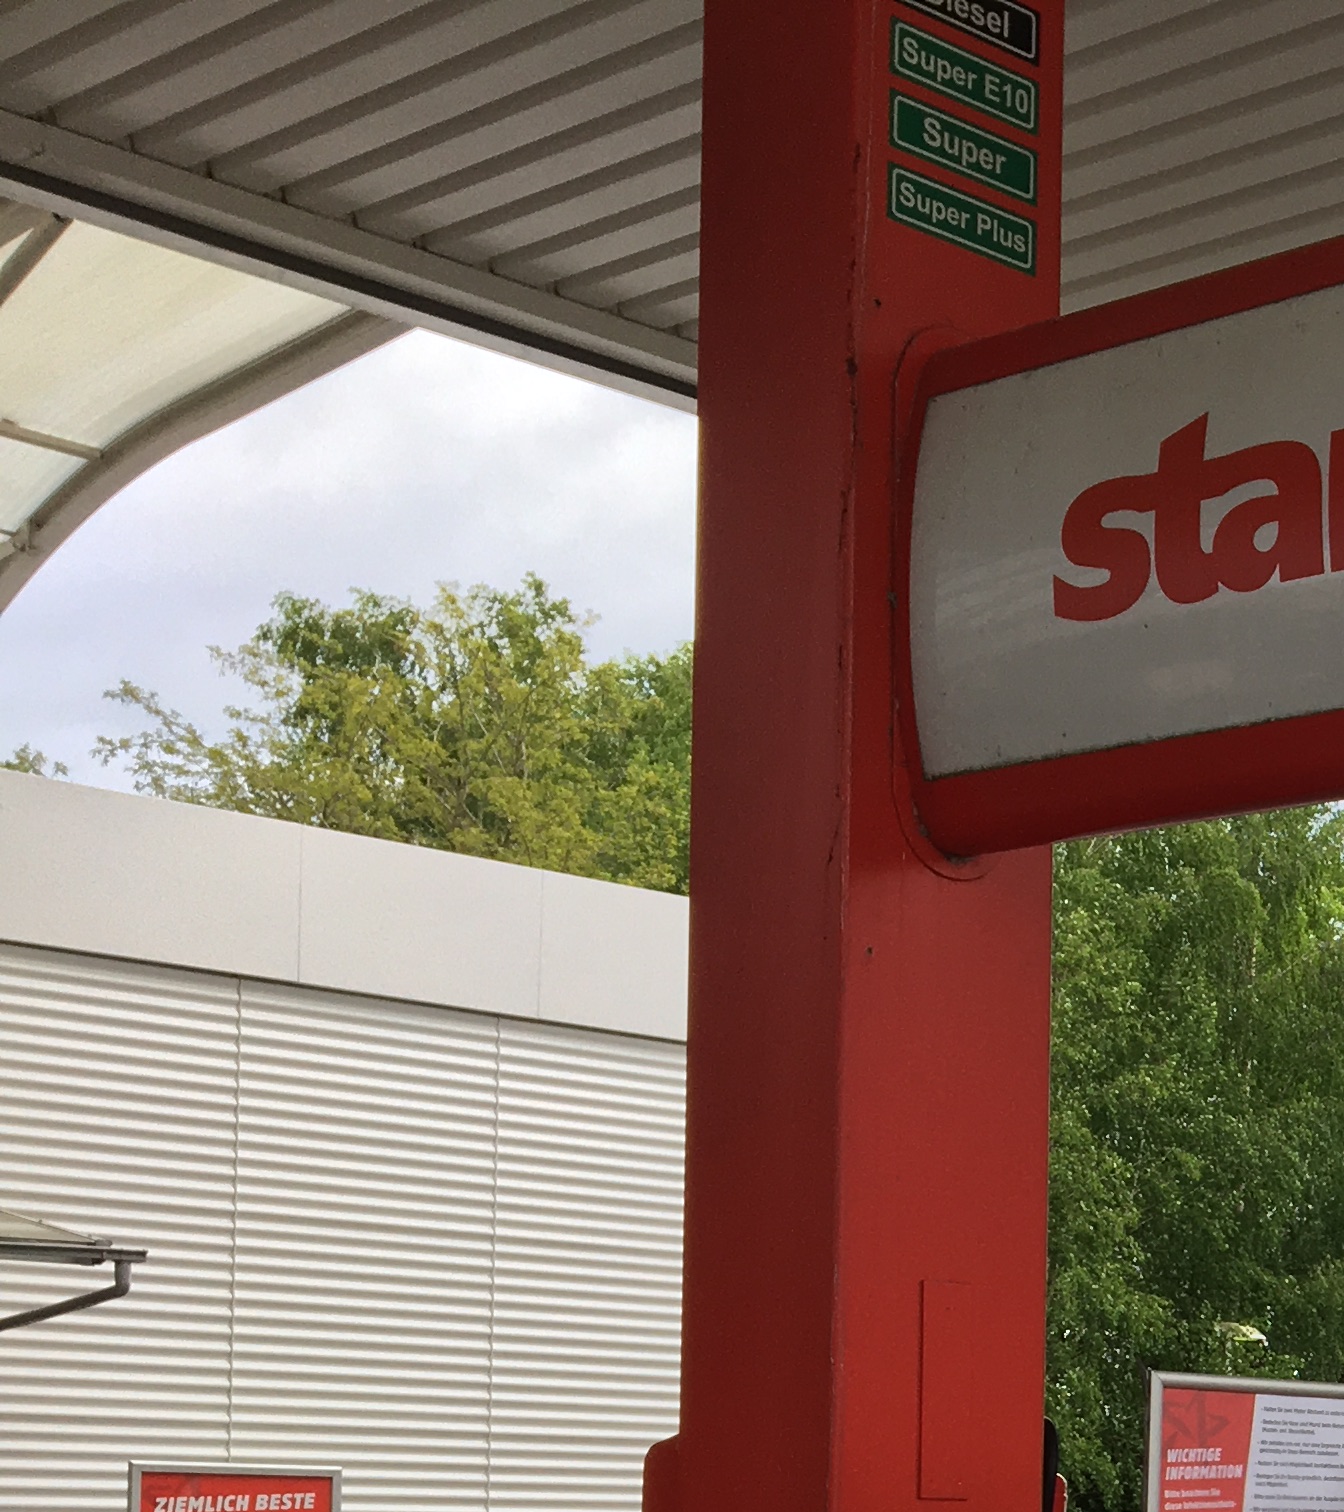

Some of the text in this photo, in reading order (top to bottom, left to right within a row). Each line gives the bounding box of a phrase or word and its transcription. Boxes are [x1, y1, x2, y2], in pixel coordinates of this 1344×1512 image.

[925, 0, 1009, 38] iesel
[902, 36, 1029, 115] Super E10
[922, 117, 1006, 175] Super
[899, 181, 1026, 253] Super Plus
[1165, 1464, 1243, 1480] INFORMATION
[1167, 1448, 1222, 1463] WICHTIGE
[254, 1492, 316, 1511] BESTE
